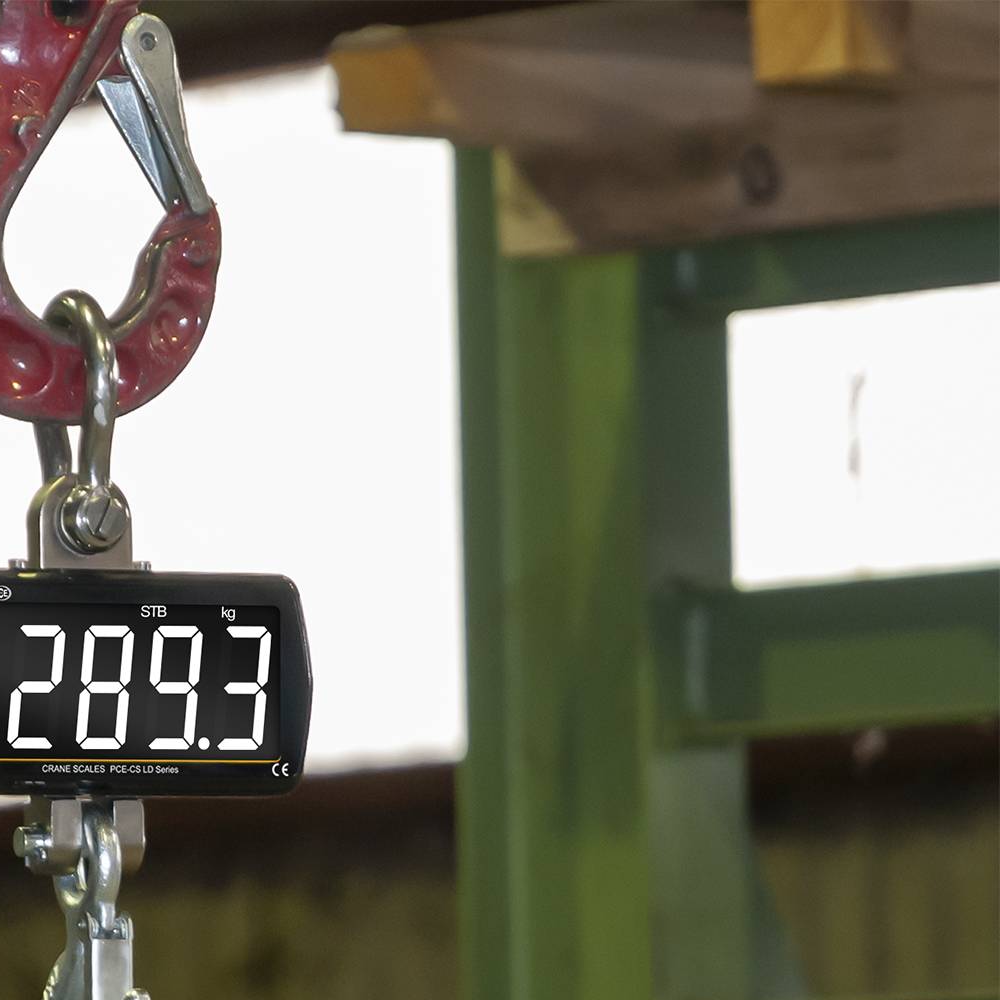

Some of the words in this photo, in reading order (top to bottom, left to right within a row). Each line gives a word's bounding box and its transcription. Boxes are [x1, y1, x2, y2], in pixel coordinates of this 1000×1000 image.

[140, 605, 168, 618] STB
[221, 606, 236, 622] kg
[6, 624, 272, 751] 289.3
[41, 764, 71, 774] CRANE
[72, 764, 106, 774] SCALES
[109, 765, 142, 774] PCE-CS
[142, 765, 154, 774] LD
[155, 765, 180, 774] Series
